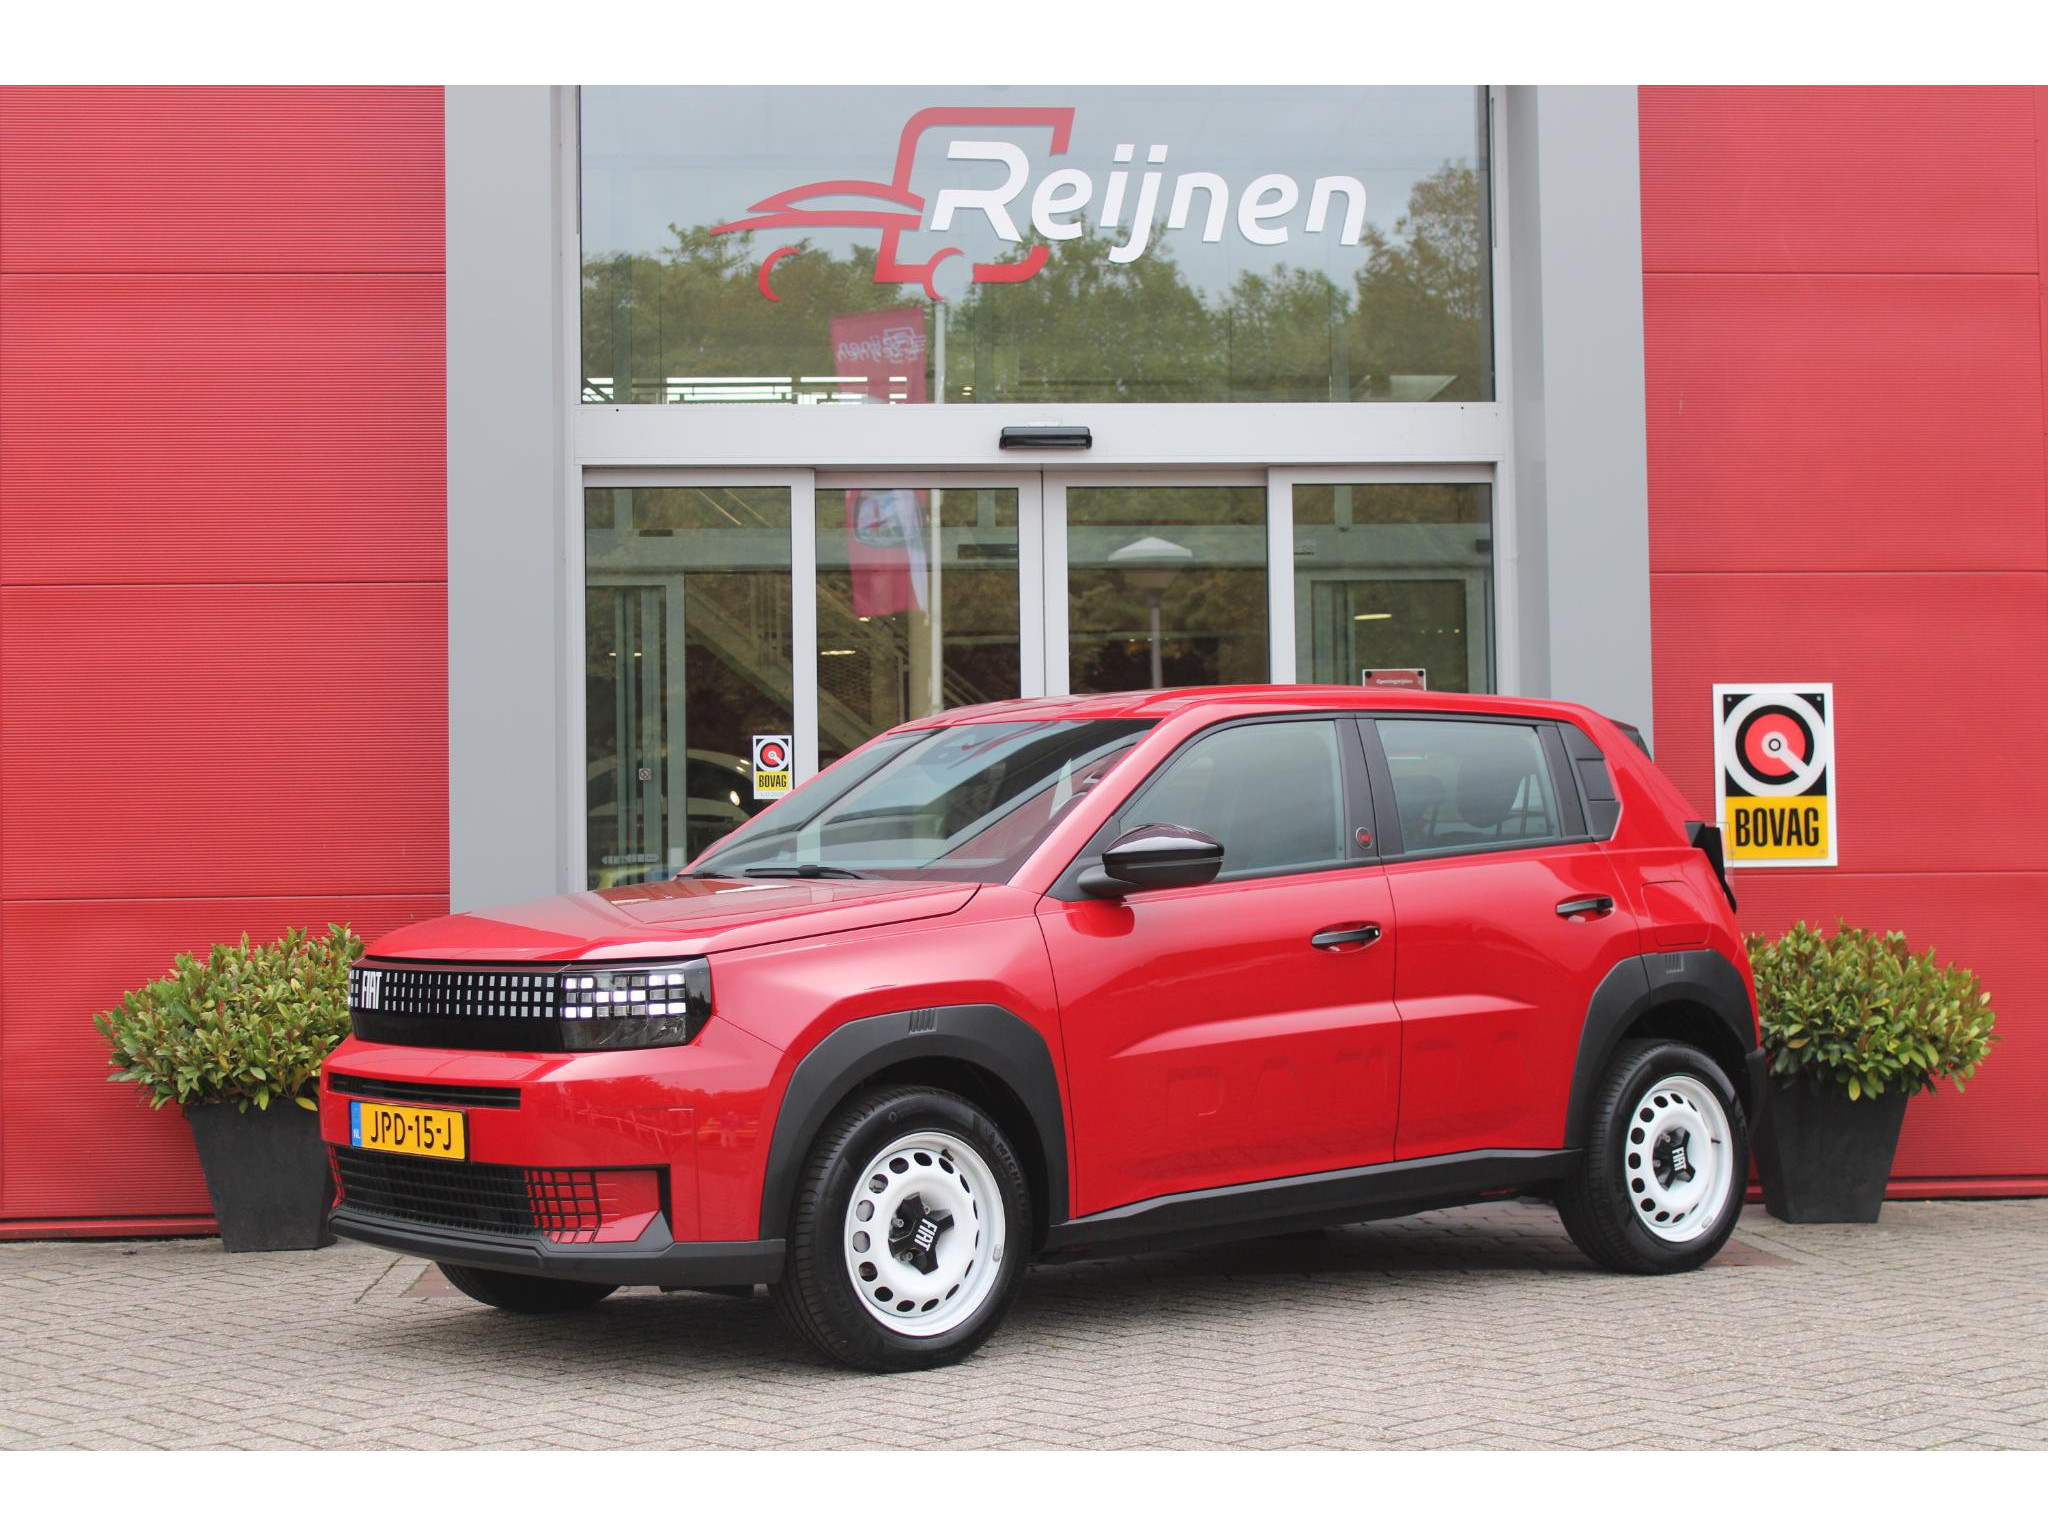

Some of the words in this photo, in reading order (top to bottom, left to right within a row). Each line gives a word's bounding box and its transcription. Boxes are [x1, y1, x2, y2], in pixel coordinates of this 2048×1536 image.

[930, 141, 1367, 264] Reijnen
[758, 774, 787, 788] BOVAG
[1735, 807, 1820, 848] BOVAG
[361, 970, 382, 1010] FIAT
[353, 1128, 361, 1139] NL
[370, 1110, 452, 1151] JPD-15-J
[1672, 1146, 1687, 1171] FIAT
[914, 1218, 938, 1252] FIAT
